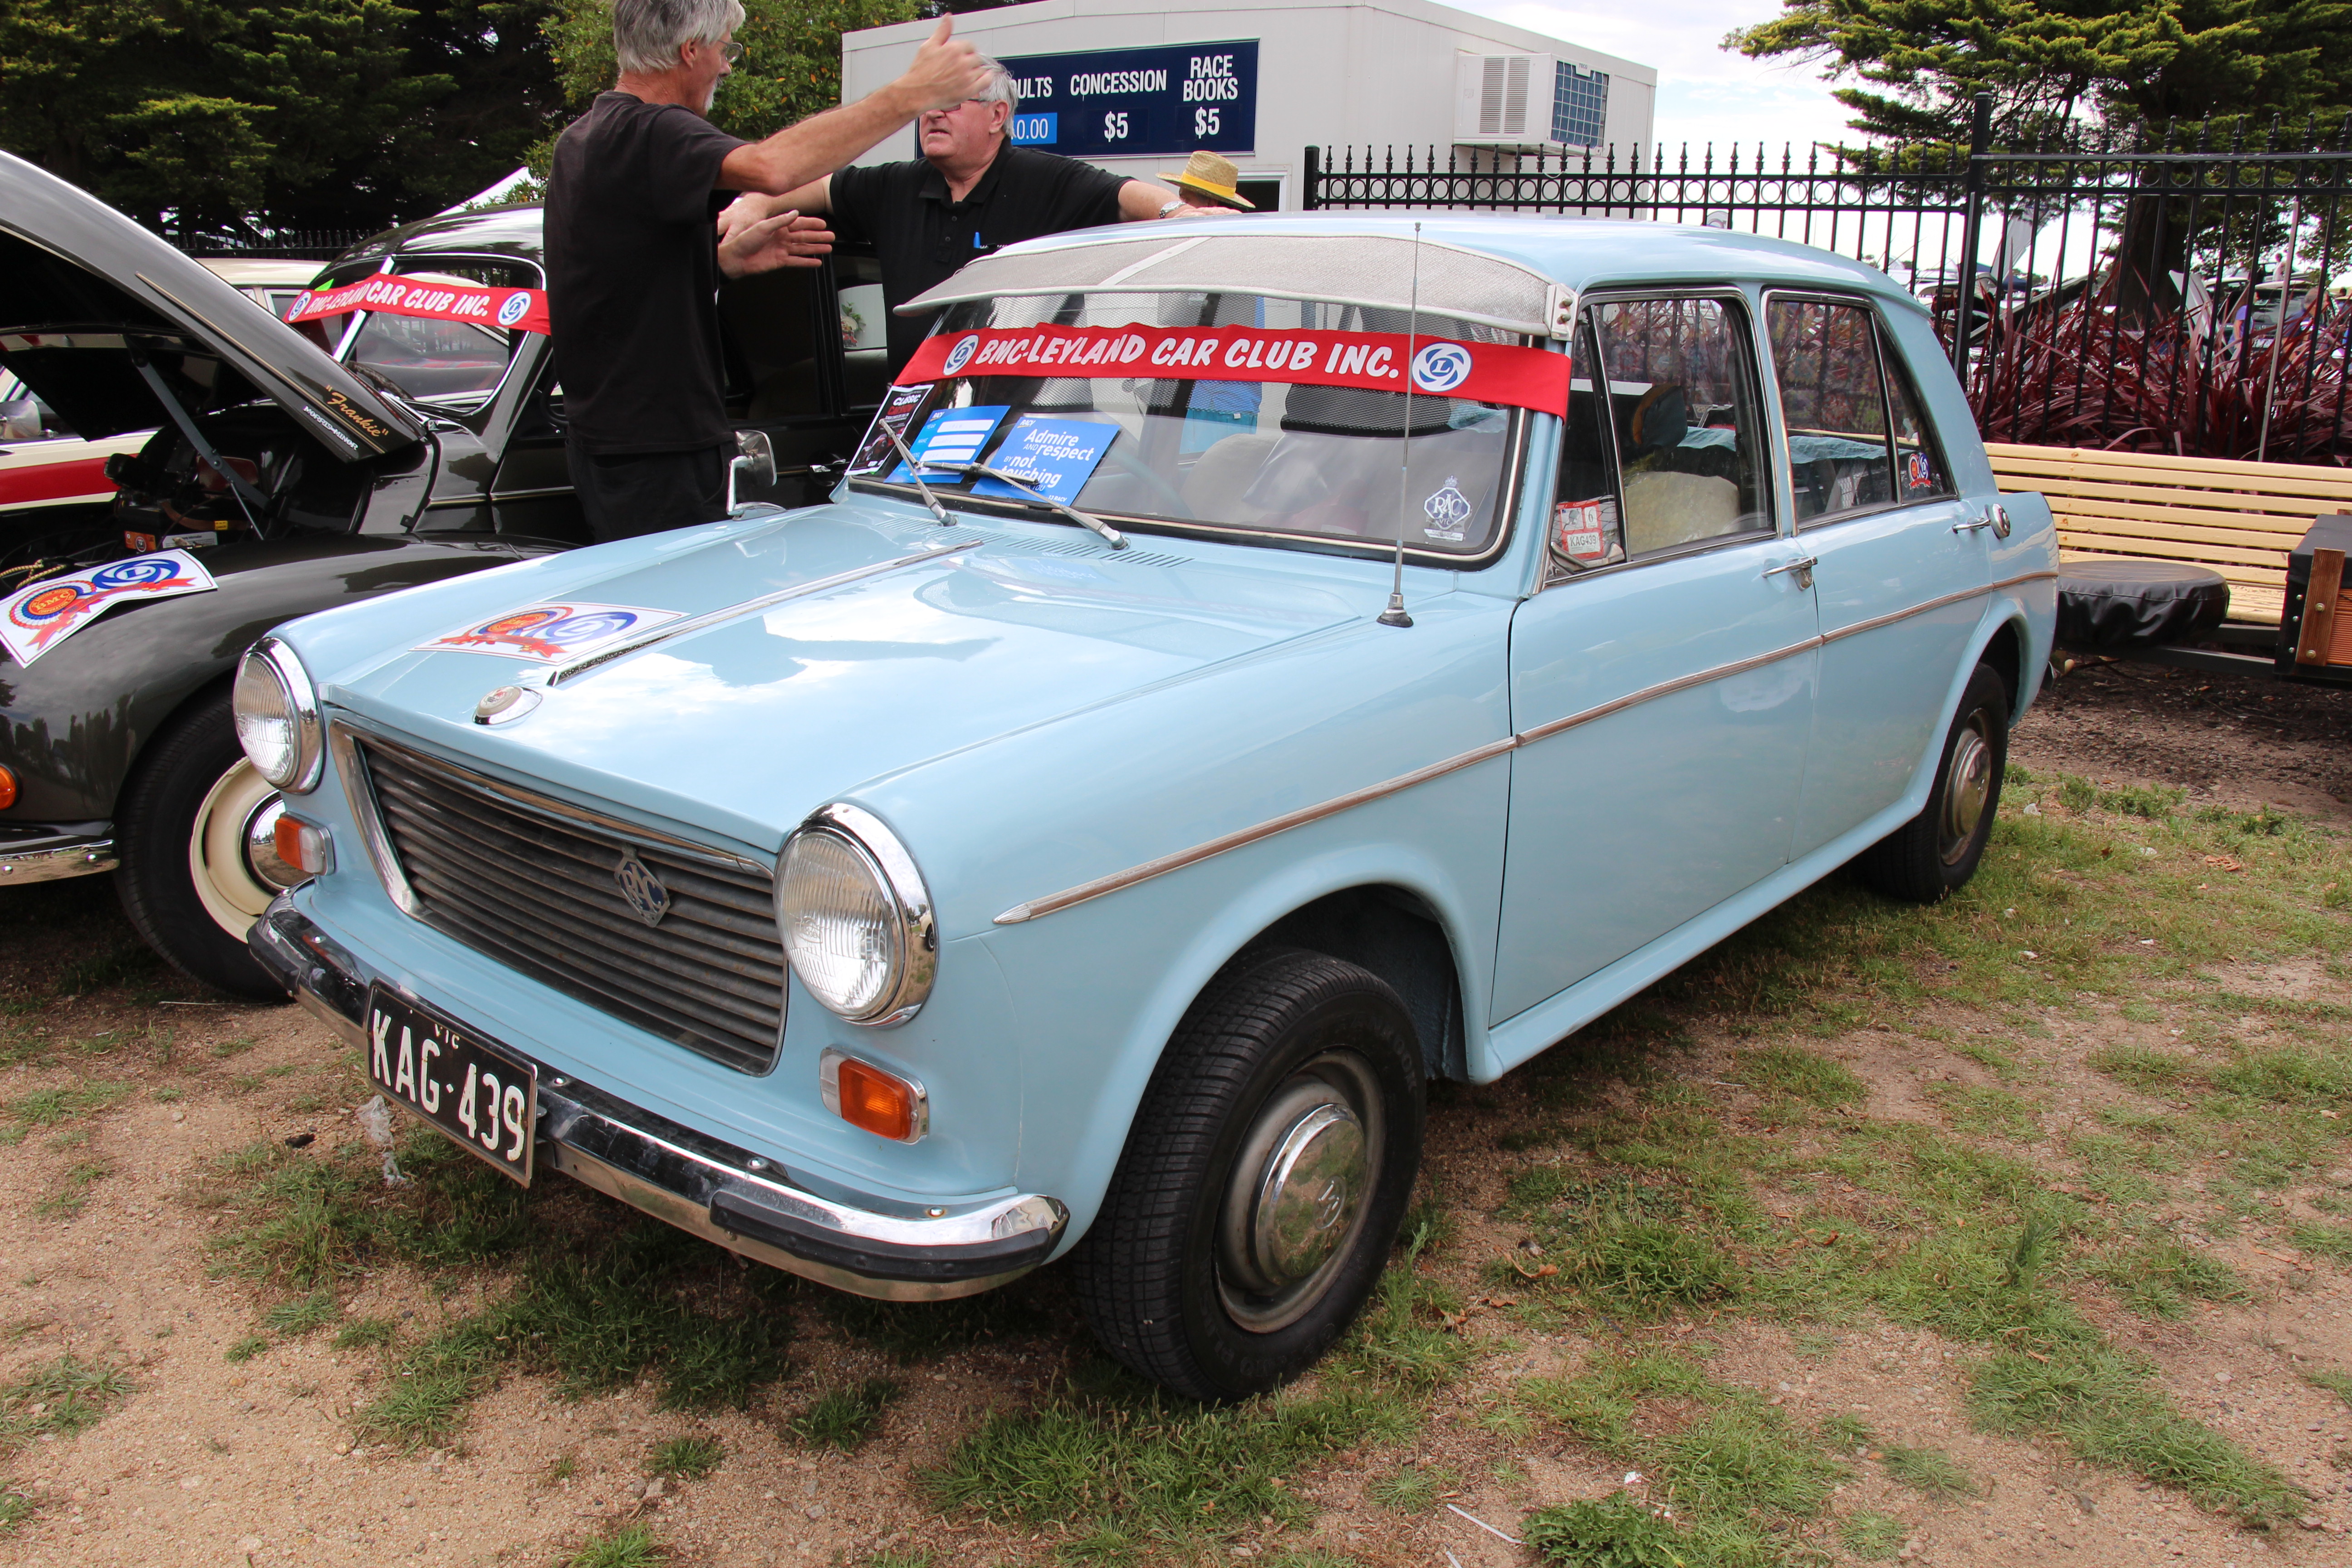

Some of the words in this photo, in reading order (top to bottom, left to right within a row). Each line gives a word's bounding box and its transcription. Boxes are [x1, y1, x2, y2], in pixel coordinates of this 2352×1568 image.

[1190, 55, 1233, 78] RACE
[1009, 76, 1052, 99] ULTS
[1070, 69, 1167, 96] CONCESSION
[1183, 78, 1238, 102] BOOKS
[1011, 118, 1049, 140] 0.00
[1104, 111, 1128, 142] $5
[1195, 106, 1220, 139] $5
[304, 283, 371, 315] BMC-LEYLAND
[366, 281, 407, 306] CAR
[404, 288, 455, 314] CLUB
[452, 294, 490, 317] INC.
[975, 334, 1146, 364] BMC-LEYLAND
[1152, 338, 1219, 366] CAR
[1225, 338, 1317, 370] CLUB
[1324, 343, 1399, 378] INC.
[893, 394, 921, 406] CLASSIC
[1024, 429, 1079, 446] Admire
[1009, 455, 1037, 468] not
[1035, 444, 1094, 461] respect
[1588, 509, 1593, 523] 6
[1570, 535, 1596, 547] KAG439
[35, 592, 70, 611] BMC
[435, 1024, 460, 1049] VIC
